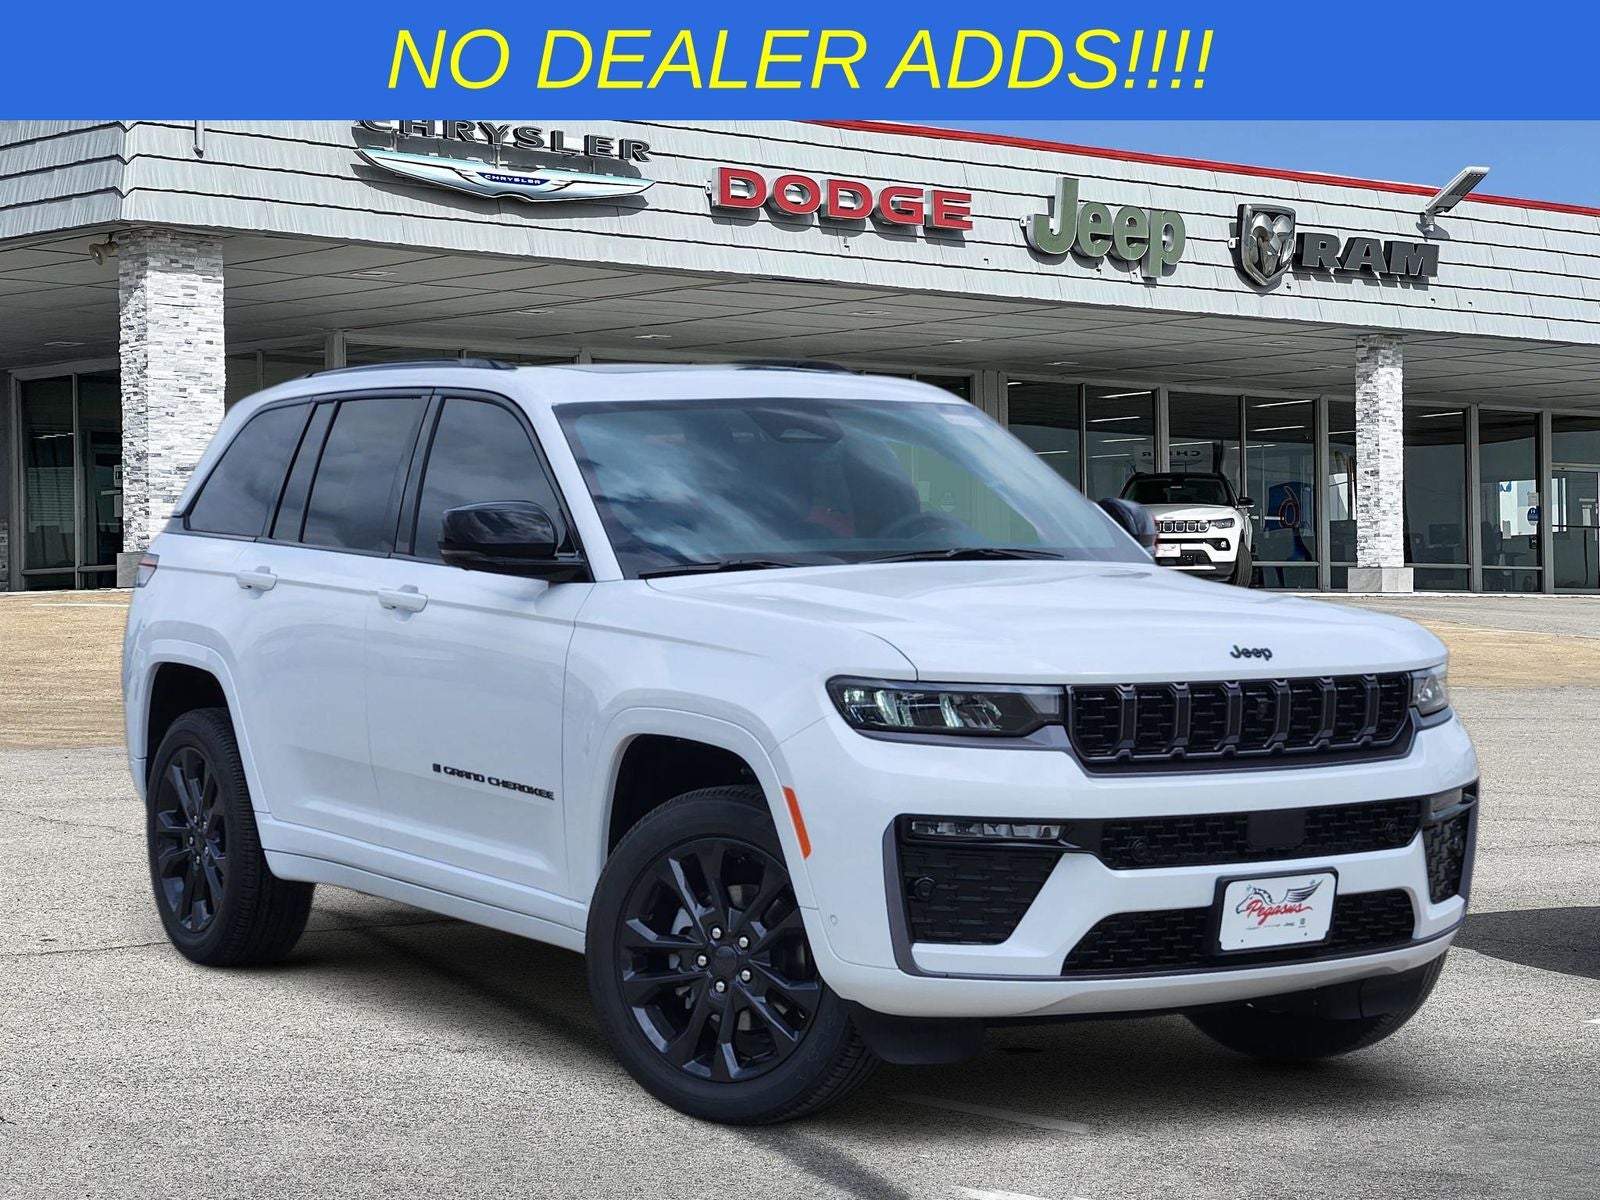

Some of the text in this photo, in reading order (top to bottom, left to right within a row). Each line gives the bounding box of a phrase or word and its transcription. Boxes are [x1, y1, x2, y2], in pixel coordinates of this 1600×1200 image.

[484, 174, 541, 185] CHRYSLER
[713, 166, 974, 231] DODGE
[1027, 176, 1187, 278] Jeep
[1294, 231, 1440, 277] RAM
[1229, 644, 1273, 661] Jeep
[443, 766, 555, 801] GRAND CHEROKEE
[1245, 899, 1313, 926] Pegasus
